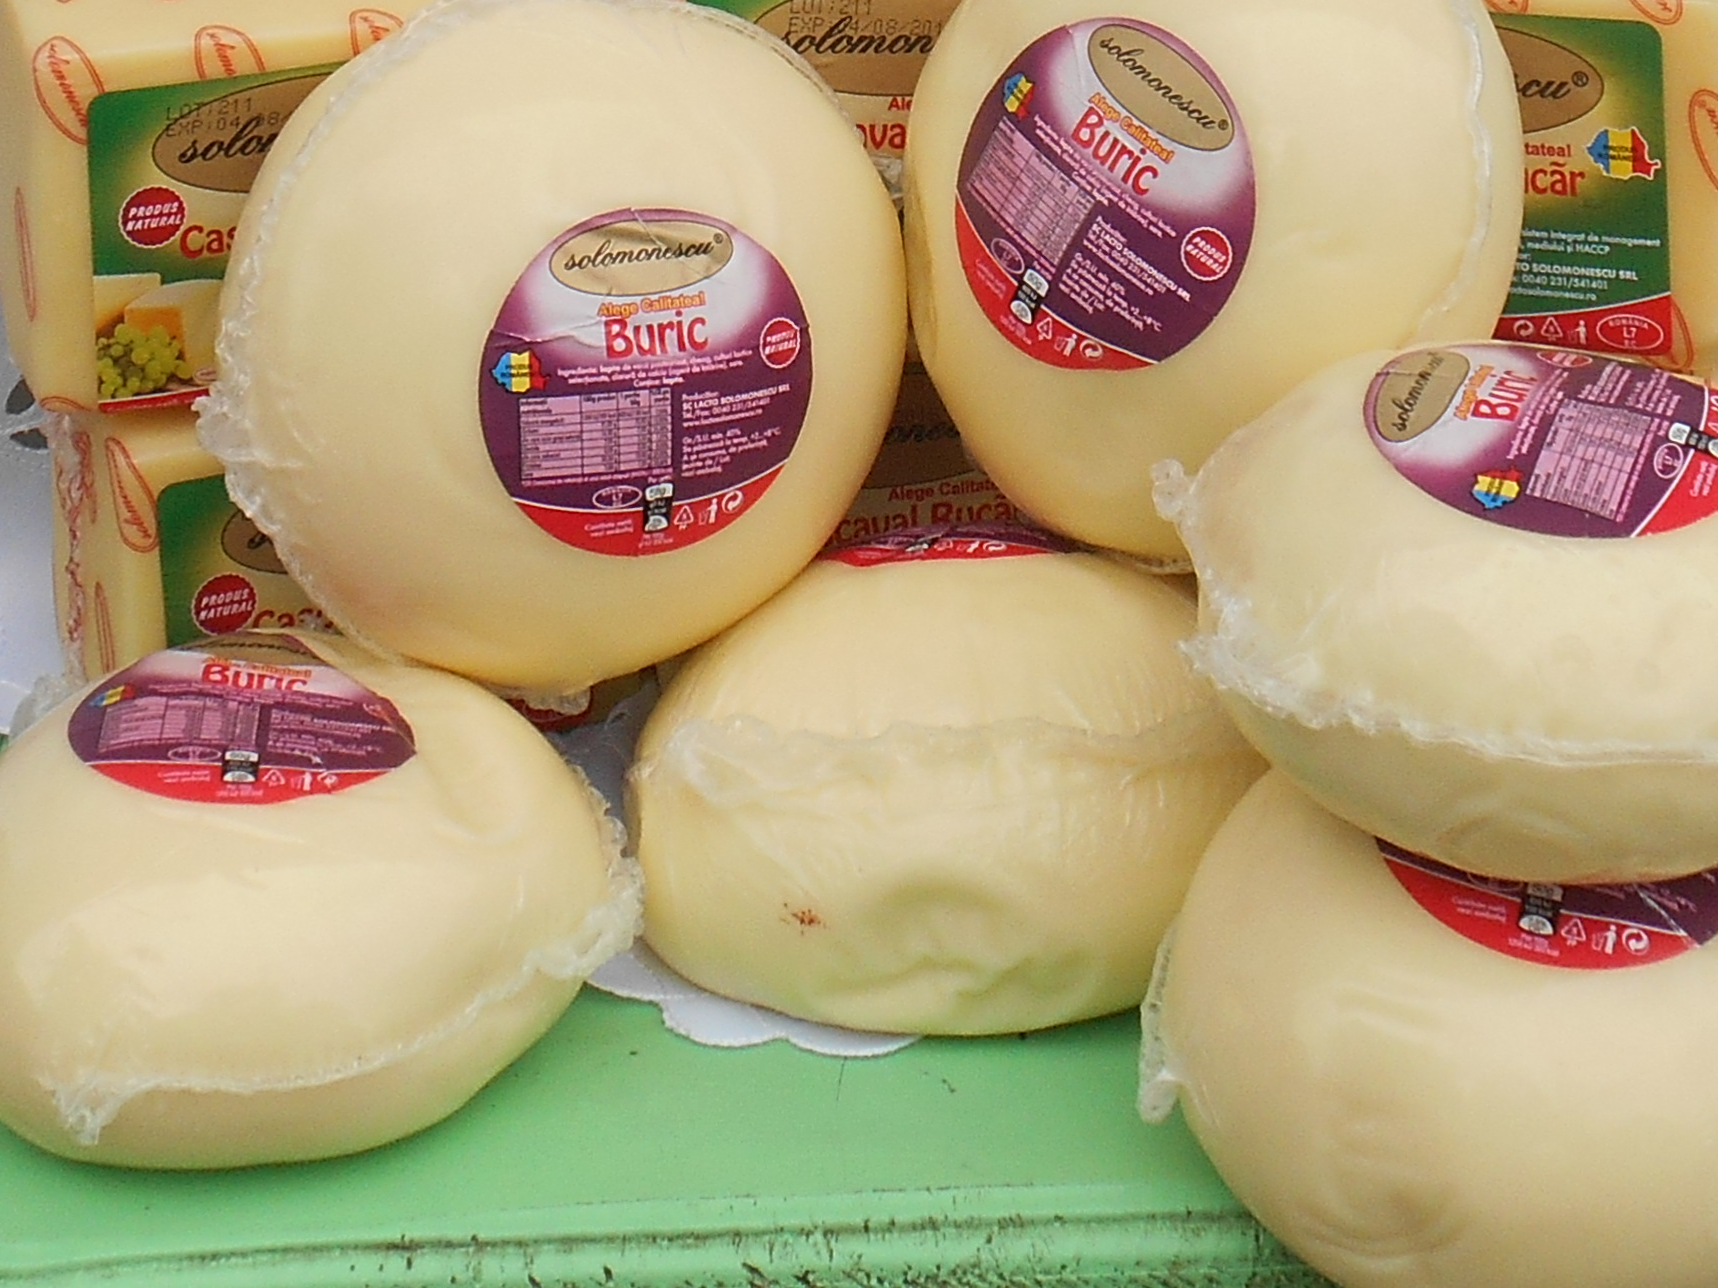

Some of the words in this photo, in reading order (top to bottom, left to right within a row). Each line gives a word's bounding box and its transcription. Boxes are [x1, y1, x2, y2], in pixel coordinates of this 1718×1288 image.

[782, 16, 934, 55] solomon
[1089, 92, 1122, 123] Alege
[1071, 105, 1159, 197] Buric
[128, 201, 179, 219] PRODUS
[125, 213, 182, 232] NATURAL
[1185, 243, 1224, 274] NATURAL
[1192, 236, 1227, 264] PRODUS
[1575, 243, 1611, 255] HACCP
[1522, 274, 1548, 285] 0040
[1532, 264, 1617, 280] SOLOMONESCU
[1618, 269, 1638, 281] SRL
[598, 301, 638, 317] Alege
[603, 310, 709, 360] Buric
[201, 588, 250, 608] PRODUS
[199, 601, 253, 621] NATURAL
